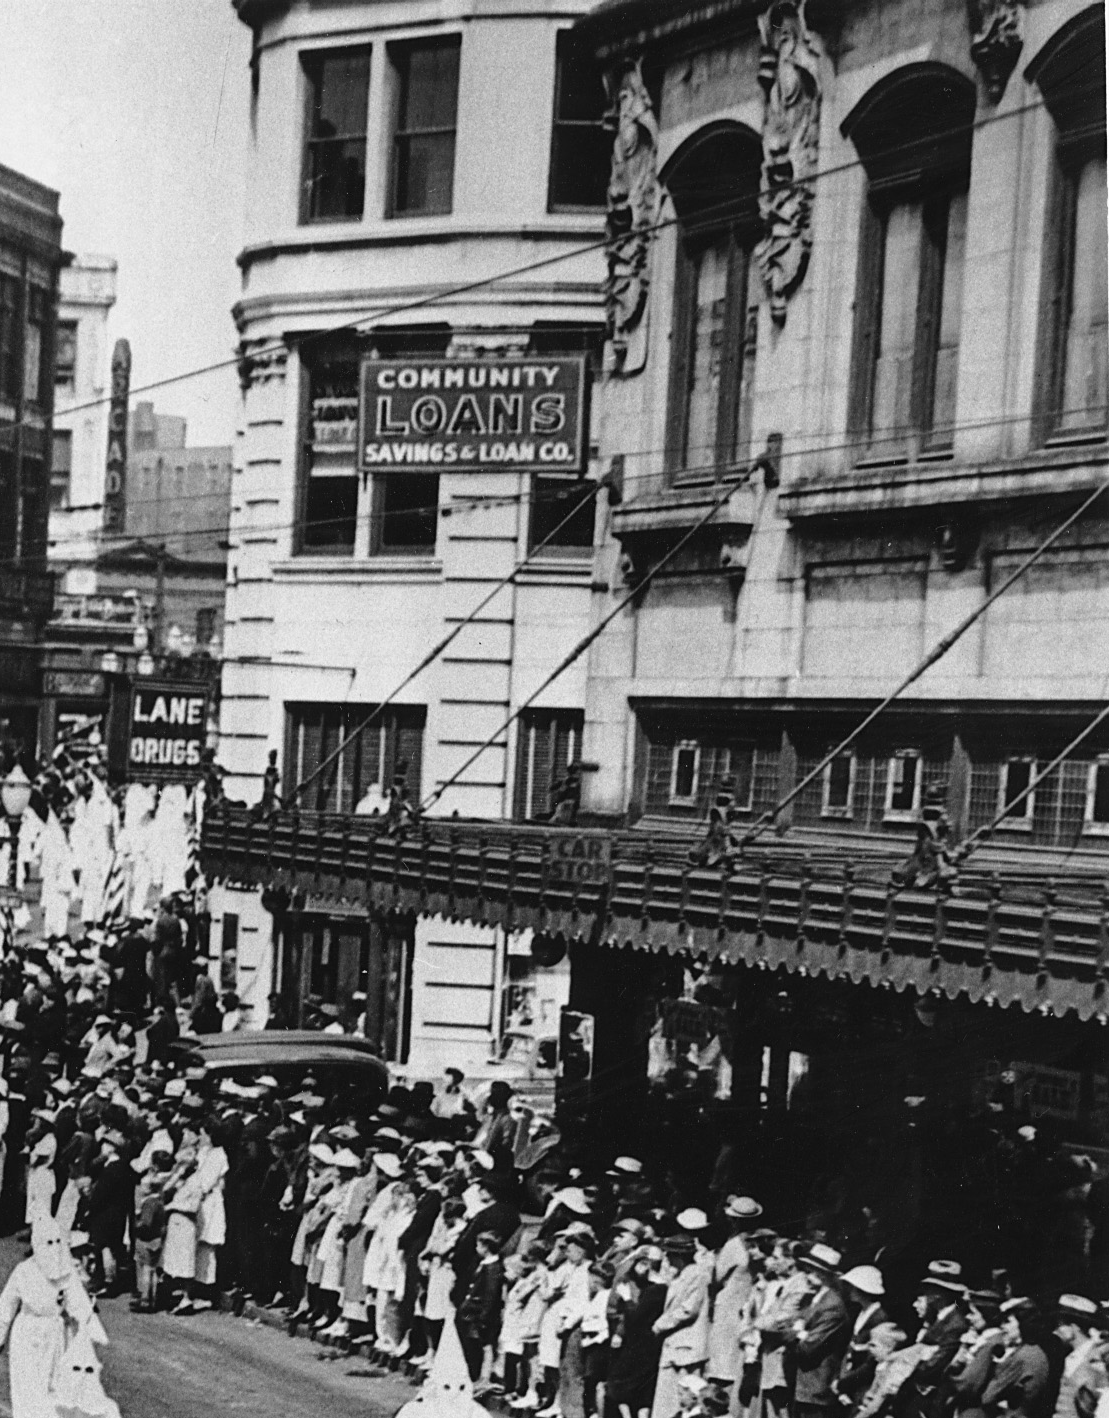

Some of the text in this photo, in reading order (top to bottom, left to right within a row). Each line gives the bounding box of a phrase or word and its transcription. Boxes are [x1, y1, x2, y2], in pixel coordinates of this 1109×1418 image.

[377, 366, 559, 388] COMMUNITY
[375, 394, 566, 436] LOANS
[366, 442, 457, 463] SAVINGS
[480, 443, 536, 463] LOAN
[539, 443, 574, 462] CO.
[134, 694, 204, 725] LANE
[130, 737, 200, 765] DRUGS
[557, 837, 603, 859] CAR
